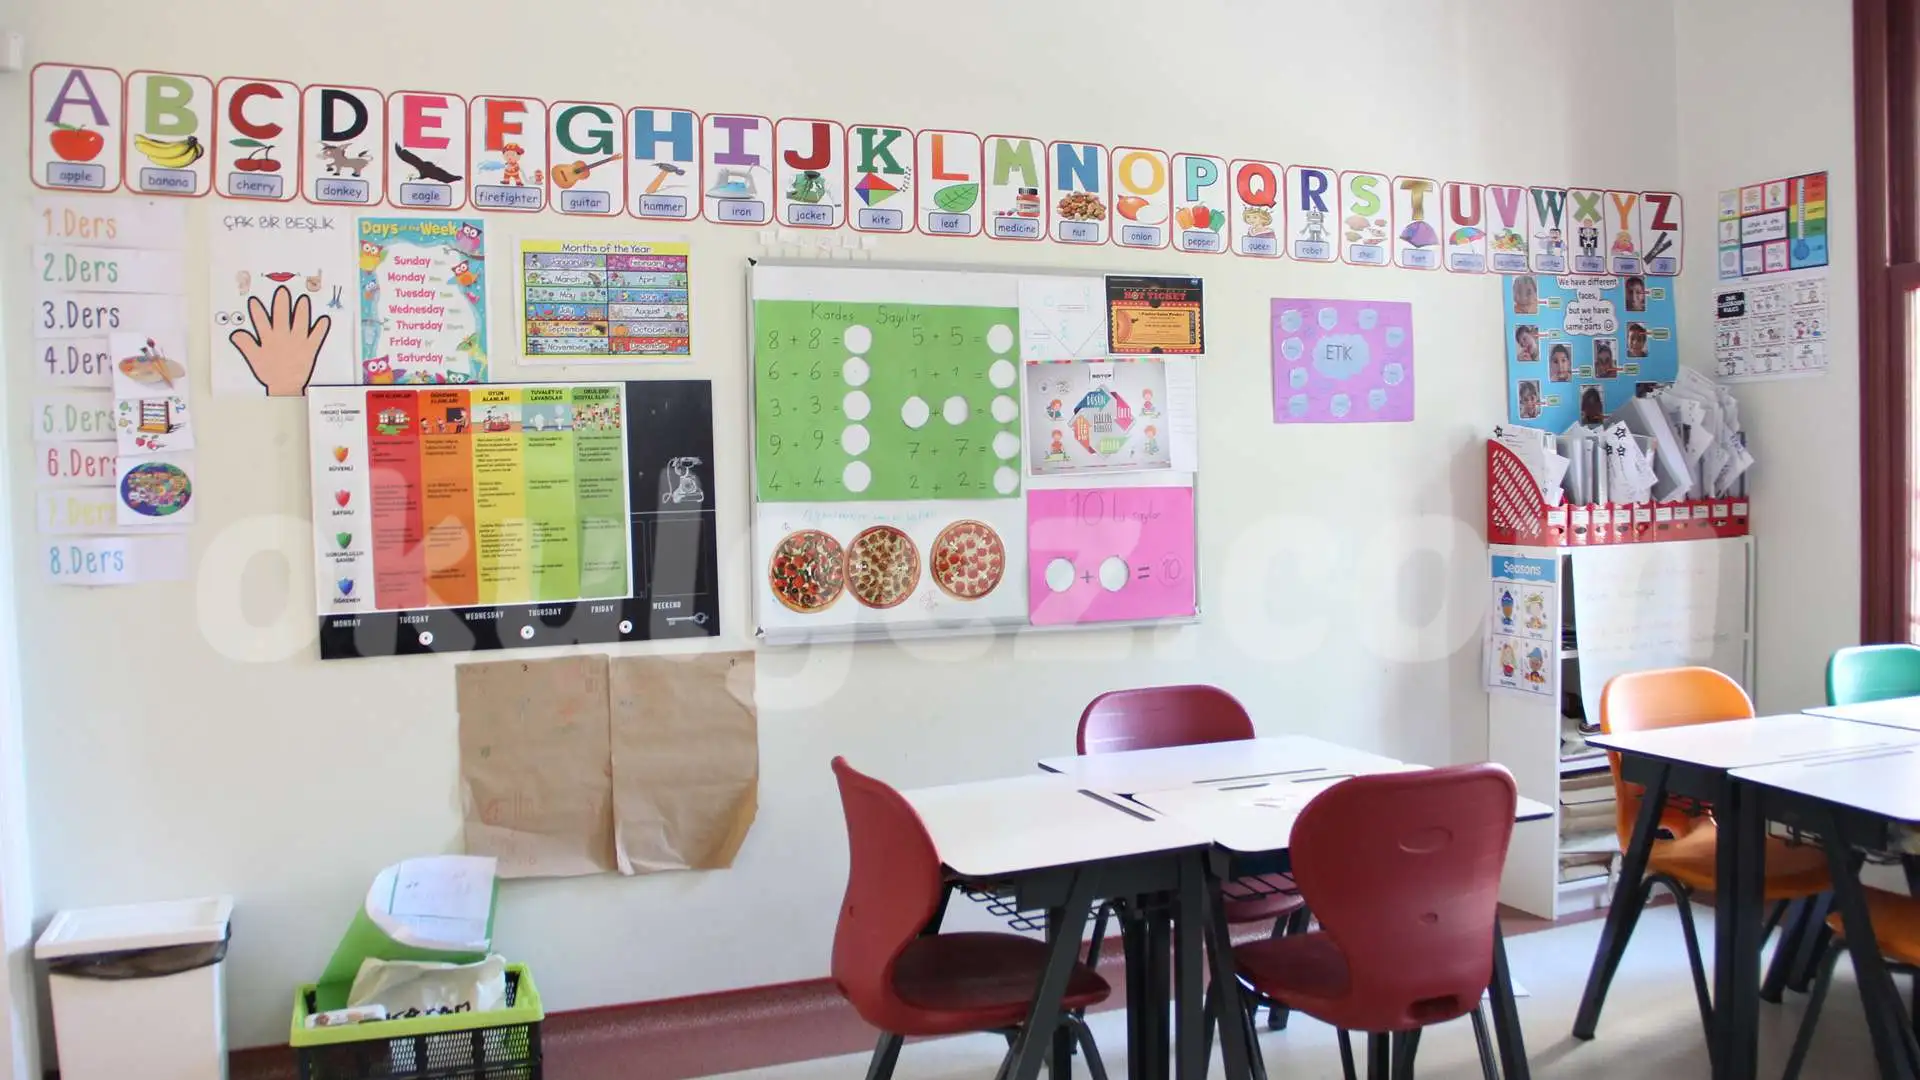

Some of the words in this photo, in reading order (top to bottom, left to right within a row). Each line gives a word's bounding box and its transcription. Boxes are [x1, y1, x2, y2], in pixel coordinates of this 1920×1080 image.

[45, 69, 110, 126] A
[145, 75, 198, 135] B
[228, 83, 284, 139] C
[318, 89, 369, 142] D
[403, 95, 450, 149] E
[484, 98, 528, 152] F
[555, 105, 614, 155] G
[634, 110, 694, 162] H
[713, 117, 760, 166] I
[783, 122, 830, 170] J
[856, 127, 905, 175] K
[931, 134, 969, 181] L
[993, 138, 1039, 187] M
[1056, 143, 1099, 193] N
[59, 170, 92, 184] apple
[1118, 151, 1165, 195] O
[1185, 156, 1218, 202] P
[149, 175, 189, 188] banana
[236, 179, 275, 194] cherry
[1236, 163, 1277, 208] Q
[323, 185, 363, 199] donkey
[411, 190, 440, 202] eagle
[479, 191, 539, 205] firefighter
[1300, 169, 1329, 213] R
[1350, 175, 1381, 217] S
[570, 196, 602, 208] guitar
[643, 201, 684, 213] hammer
[1401, 180, 1434, 221] T
[1449, 185, 1482, 227] U
[1492, 187, 1521, 228] V
[1572, 191, 1602, 223] X
[731, 207, 751, 216] iron
[795, 210, 827, 222] jacket
[1530, 188, 1567, 229] W
[1611, 192, 1637, 231] Y
[1645, 194, 1678, 231] Z
[43, 208, 117, 239] 1.Ders
[872, 214, 891, 225] kite
[940, 217, 959, 229] leaf
[361, 221, 398, 239] Days
[420, 221, 458, 237] Week
[998, 221, 1036, 234] medicine
[1072, 228, 1086, 237] nut
[1130, 232, 1153, 242] onion
[1188, 237, 1216, 248] pepper
[561, 243, 597, 253] Months
[600, 243, 611, 253] of
[615, 244, 630, 253] the
[631, 244, 651, 254] Year
[43, 252, 119, 283] 2.Ders
[394, 256, 431, 268] Sunday
[388, 272, 425, 284] Monday
[554, 275, 581, 284] March
[638, 275, 656, 285] April
[1588, 277, 1617, 286] different
[395, 288, 436, 300] Tuesday
[559, 290, 576, 300] May
[1147, 292, 1186, 301] TICKET
[42, 300, 120, 329] 3.Ders
[388, 304, 444, 316] Wednesday
[634, 307, 661, 316] August
[1593, 306, 1609, 315] have
[396, 320, 443, 332] Thursday
[547, 325, 589, 335] September
[1584, 323, 1601, 332] parts
[389, 337, 422, 349] Friday
[769, 330, 779, 349] 8
[808, 327, 821, 349] 8
[912, 327, 924, 346] 5
[951, 326, 964, 346] 5
[547, 343, 586, 352] November
[45, 346, 113, 375] 4.Der
[397, 353, 443, 366] Saturday
[768, 361, 779, 380] 6
[810, 361, 821, 380] 6
[911, 367, 917, 378] 1
[952, 366, 959, 377] 1
[770, 398, 781, 417] 3
[810, 395, 821, 414] 3
[769, 434, 781, 456] 9
[813, 429, 823, 450] 9
[907, 441, 920, 459] 7
[955, 438, 969, 456] 7
[769, 470, 782, 491] 4
[813, 466, 824, 486] 4
[910, 475, 919, 489] 2
[957, 471, 970, 486] 2
[50, 546, 124, 575] 8.Ders
[1504, 561, 1541, 576] Seasons
[528, 608, 562, 617] THURSDAY
[591, 605, 614, 613] FRIDAY
[652, 601, 682, 610] WEEKEND
[332, 619, 361, 627] MONDAY
[399, 615, 429, 624] TUESDAY
[465, 611, 504, 620] WEDNESDAY
